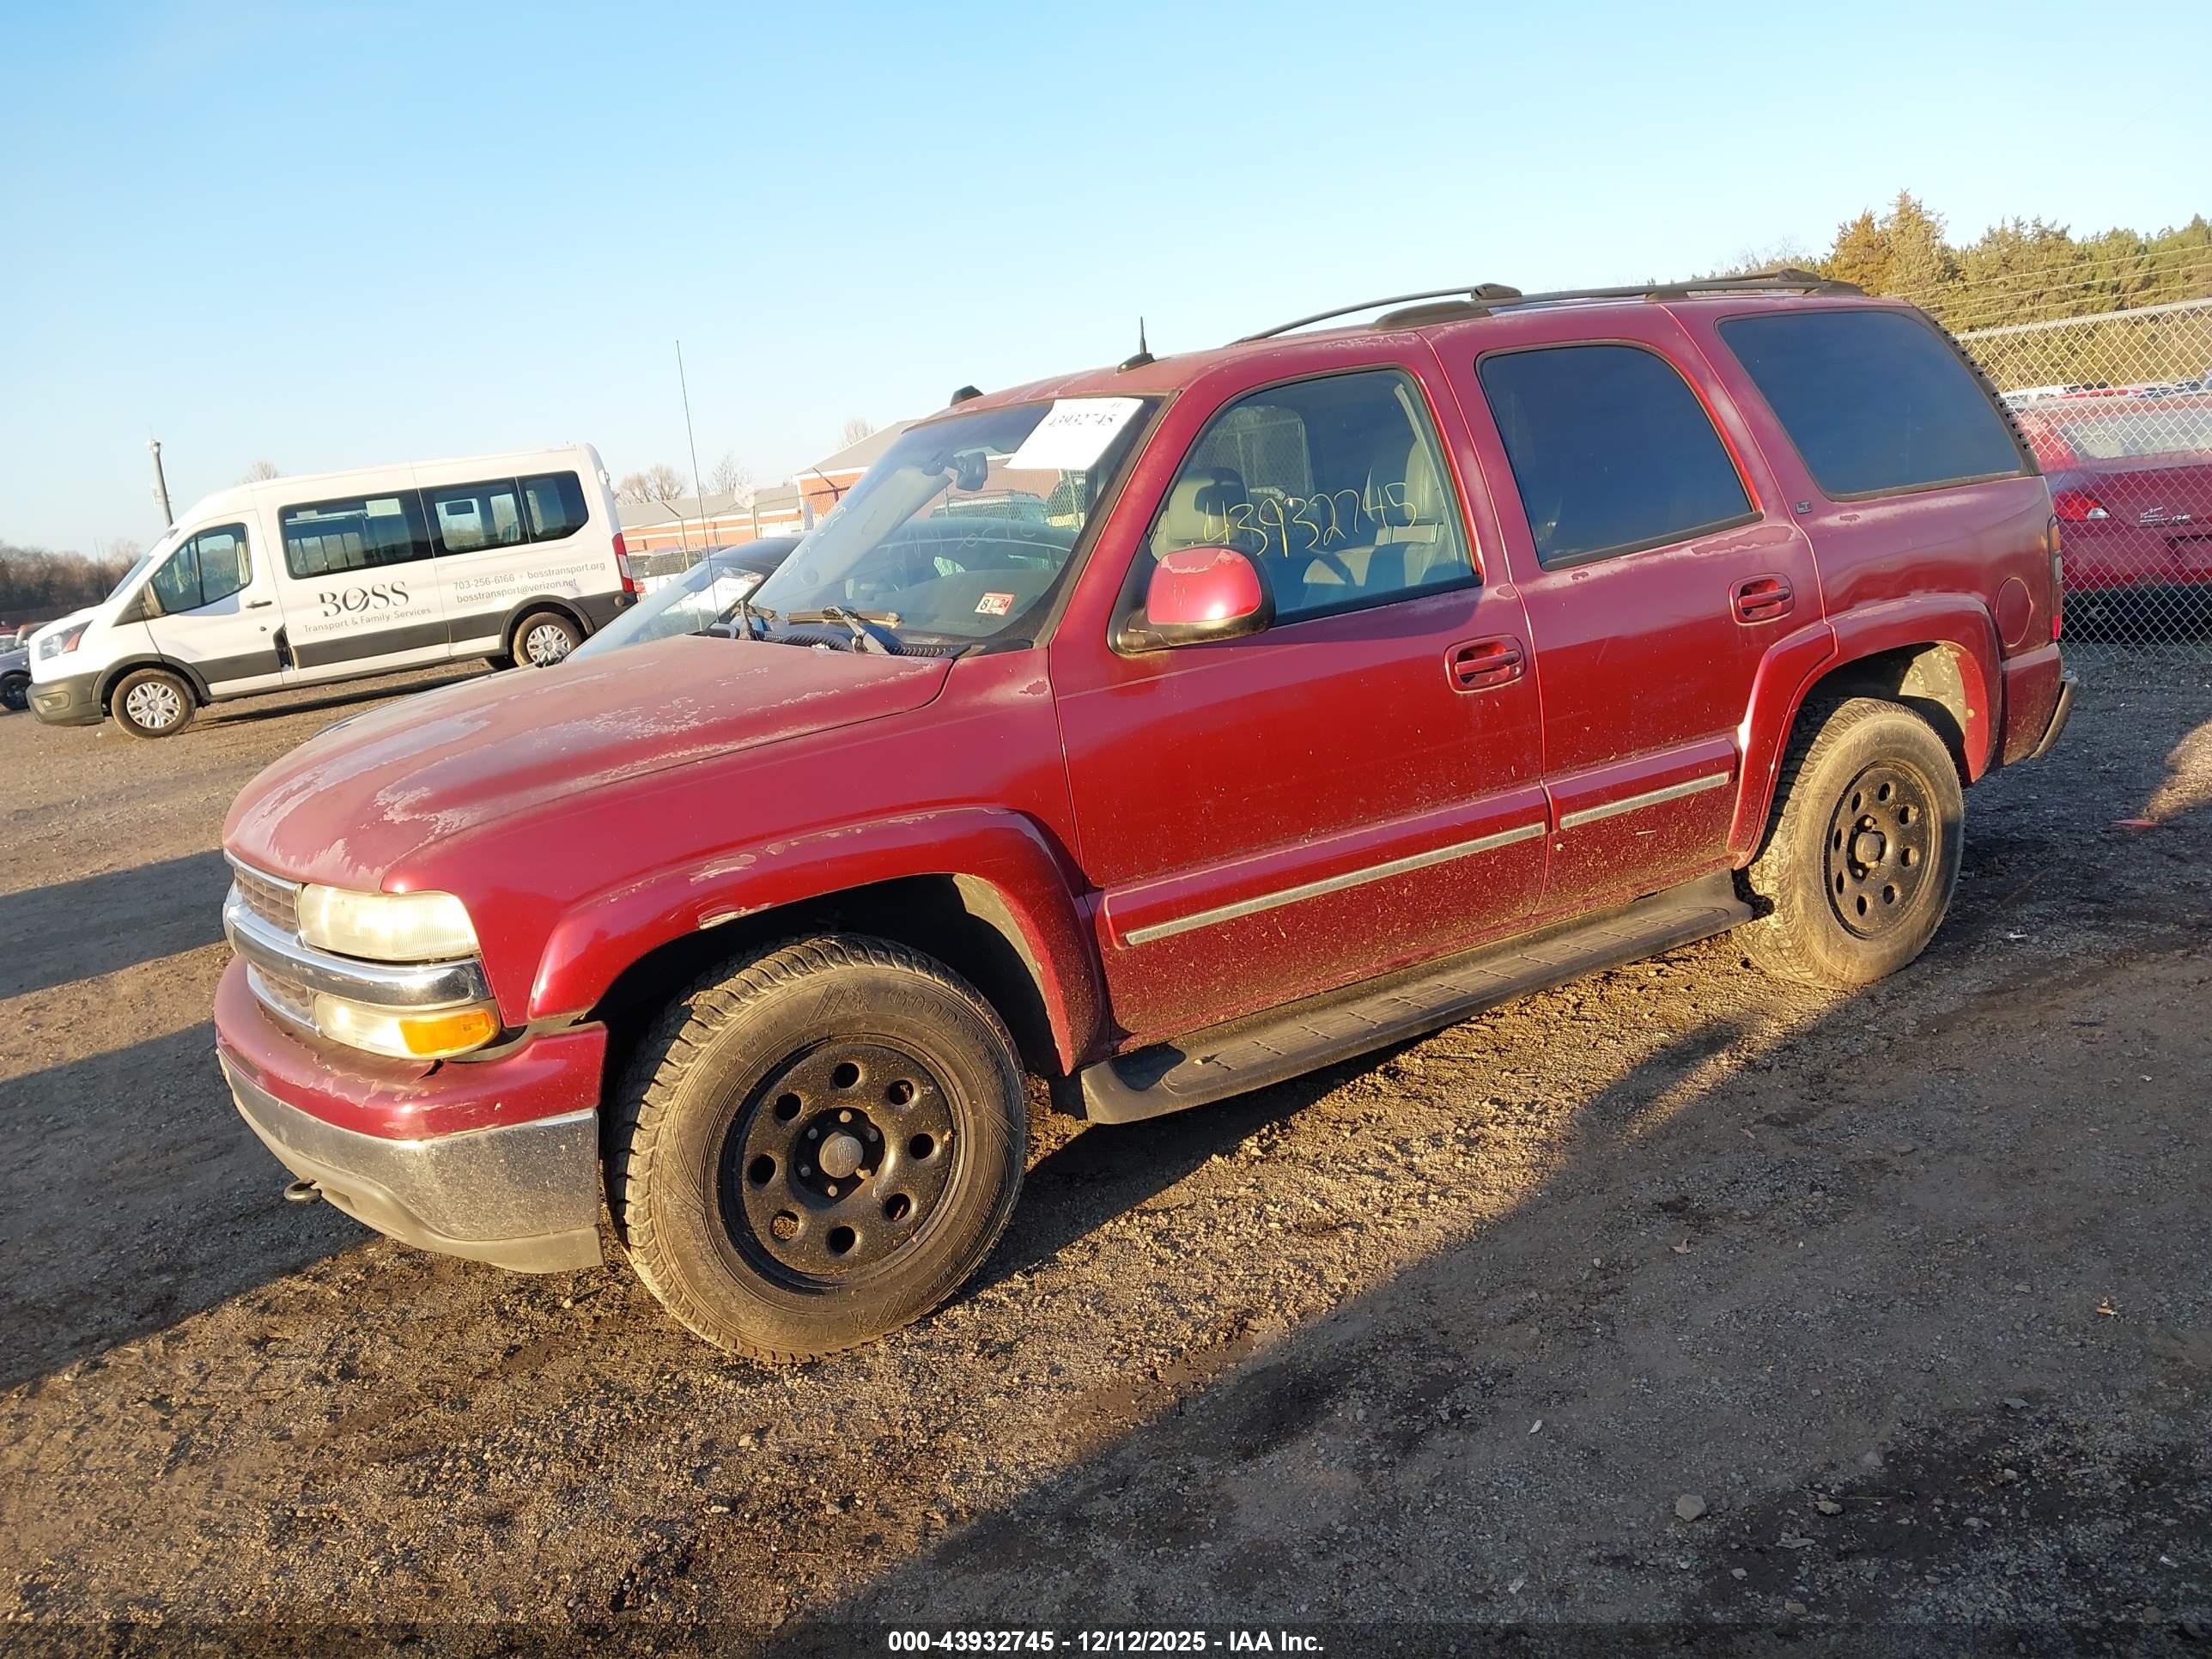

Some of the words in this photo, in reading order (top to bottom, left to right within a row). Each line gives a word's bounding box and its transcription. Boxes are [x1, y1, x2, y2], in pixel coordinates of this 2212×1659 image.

[1203, 467, 1417, 558] 43932745
[1796, 501, 1812, 514] LT
[453, 574, 515, 591] 703-256-6166
[527, 562, 605, 580] bosstransport.org
[319, 580, 410, 617] BOSS
[456, 578, 577, 603] bosstransport@verizon.net
[980, 599, 990, 611] 8
[303, 620, 349, 633] Transport
[361, 613, 390, 625] Family
[394, 607, 431, 619] Services
